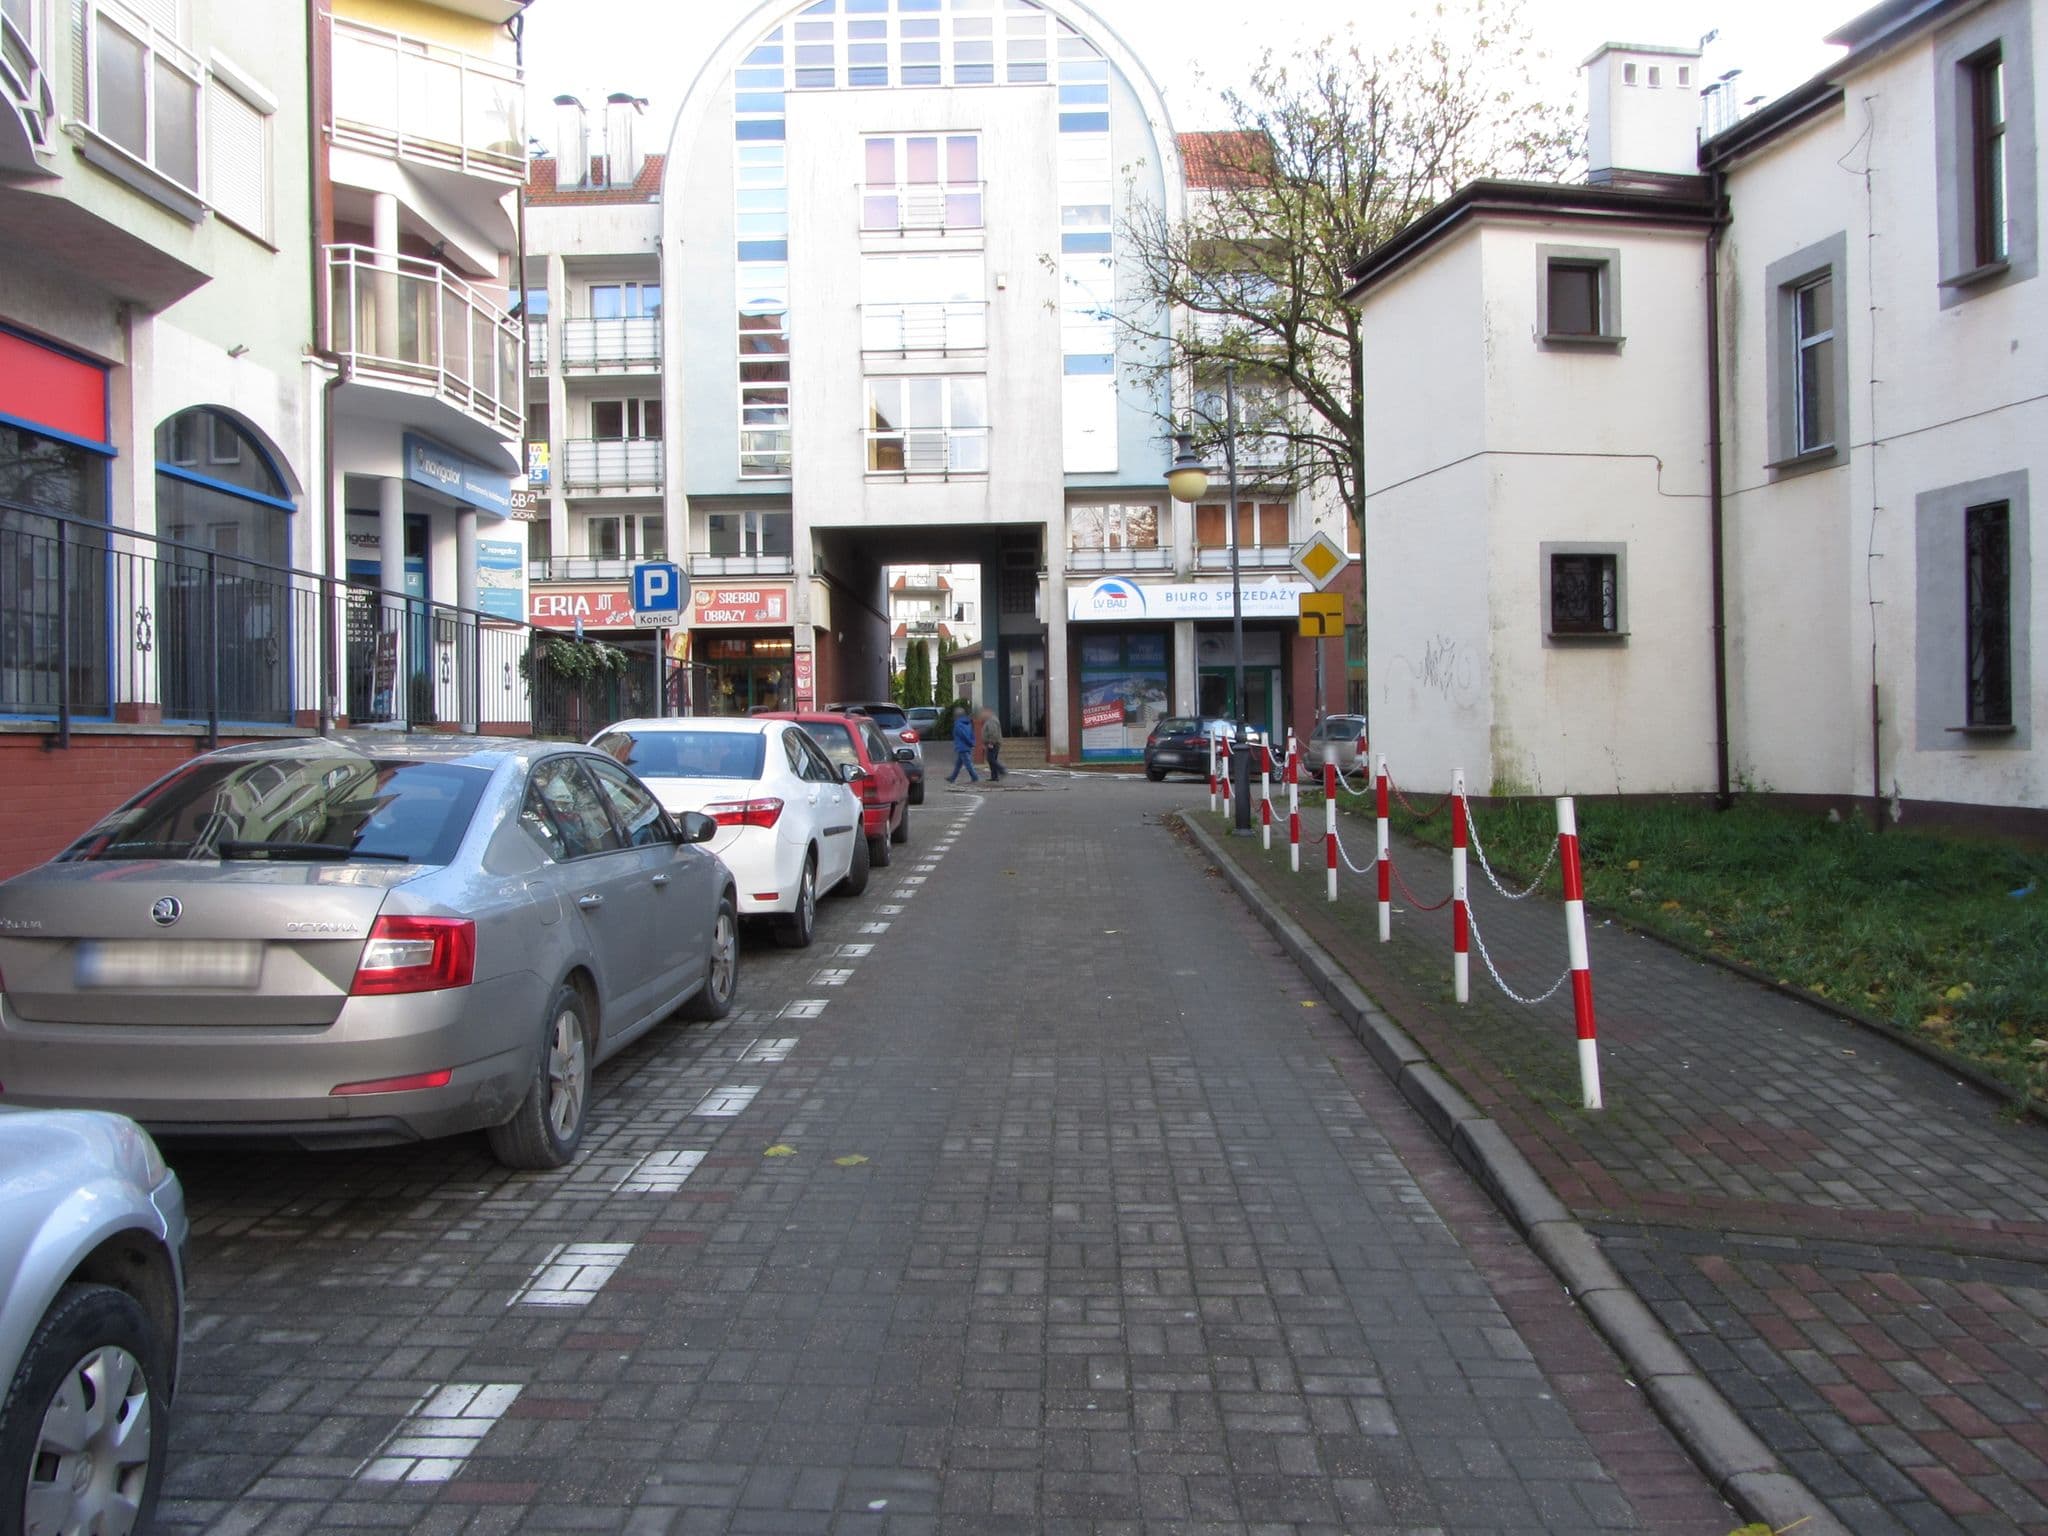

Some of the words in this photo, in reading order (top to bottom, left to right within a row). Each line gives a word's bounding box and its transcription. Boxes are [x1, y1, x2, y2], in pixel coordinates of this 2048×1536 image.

[424, 459, 461, 485] navigator
[512, 511, 536, 520] CICHA
[643, 569, 669, 607] P
[1165, 591, 1209, 602] BIURO
[1216, 587, 1296, 602] SPZEDAŻY
[718, 591, 760, 604] SREBRO
[1106, 599, 1128, 609] BAU
[531, 595, 591, 617] ERIA
[640, 615, 673, 625] Koniec
[703, 609, 746, 622] OBRAZY
[287, 921, 358, 933] OCTAVIA
